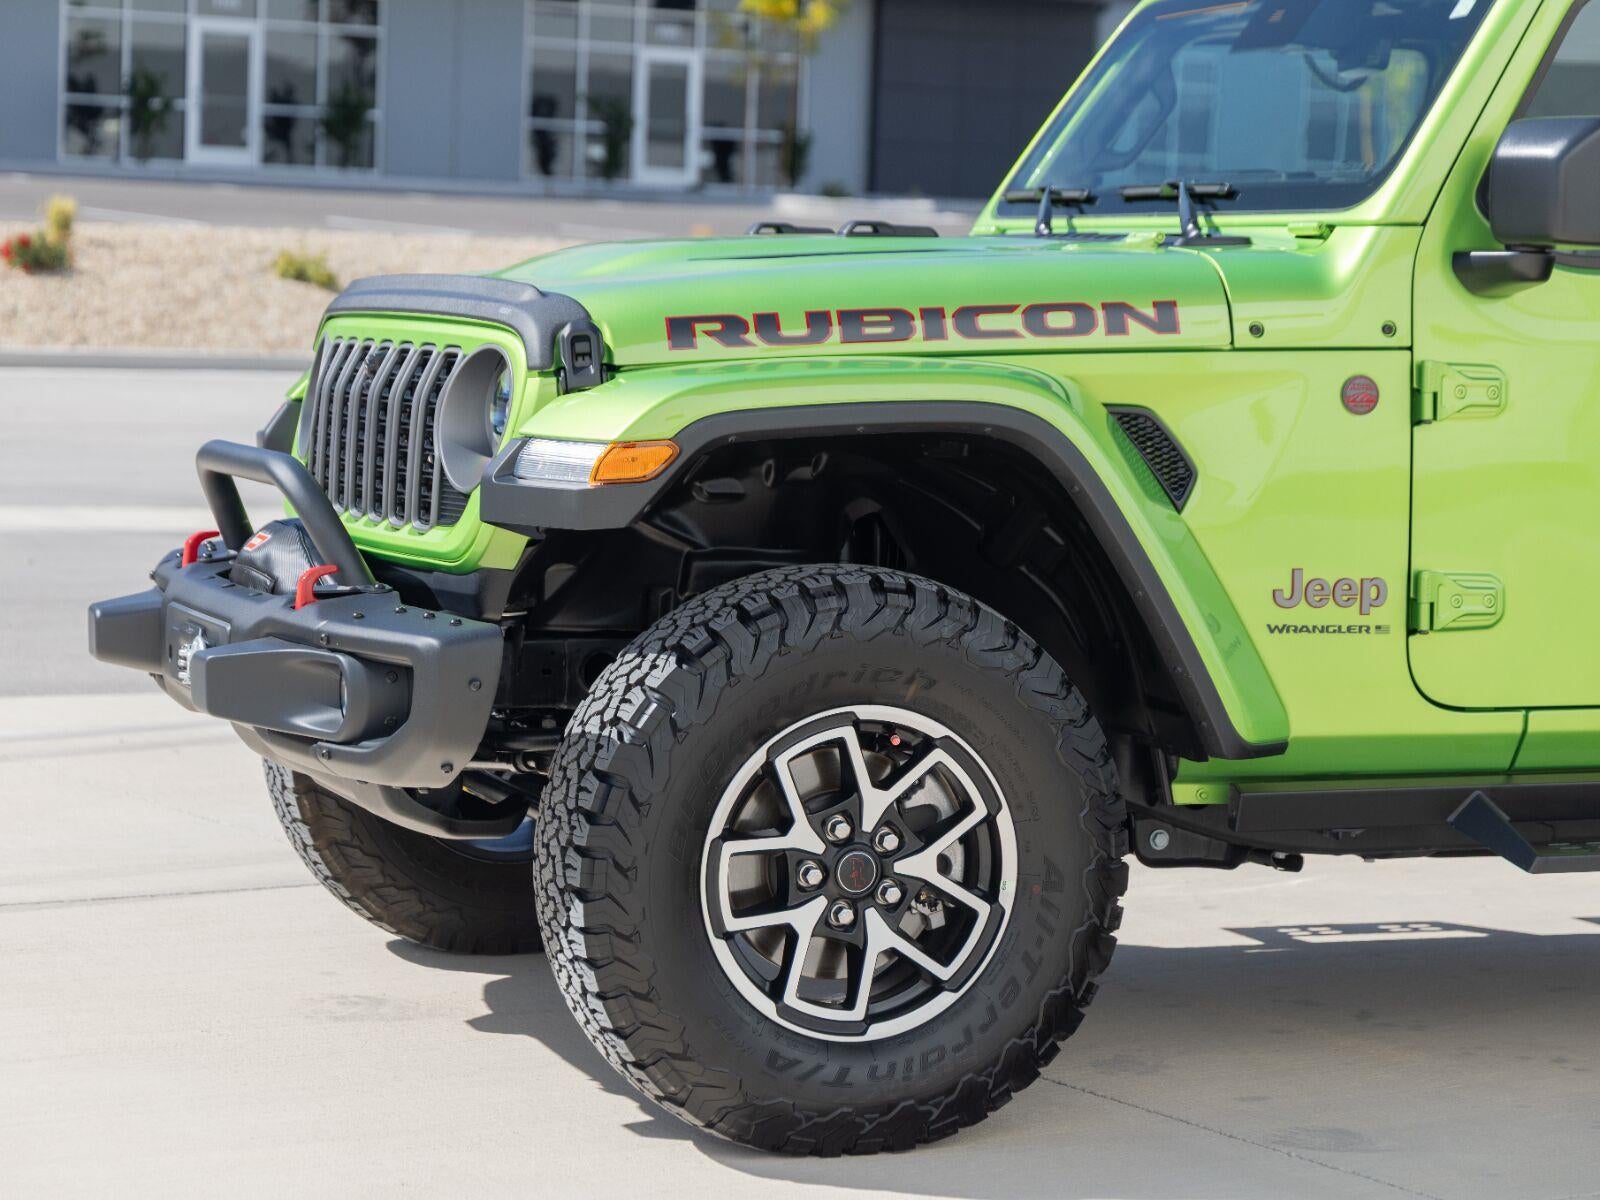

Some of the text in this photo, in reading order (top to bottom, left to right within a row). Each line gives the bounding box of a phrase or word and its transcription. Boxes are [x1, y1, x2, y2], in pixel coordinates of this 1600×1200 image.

[665, 300, 1181, 350] RUBICON
[1273, 568, 1388, 615] Jeep
[1266, 623, 1371, 634] WRANGLER
[763, 1047, 855, 1088] T/A
